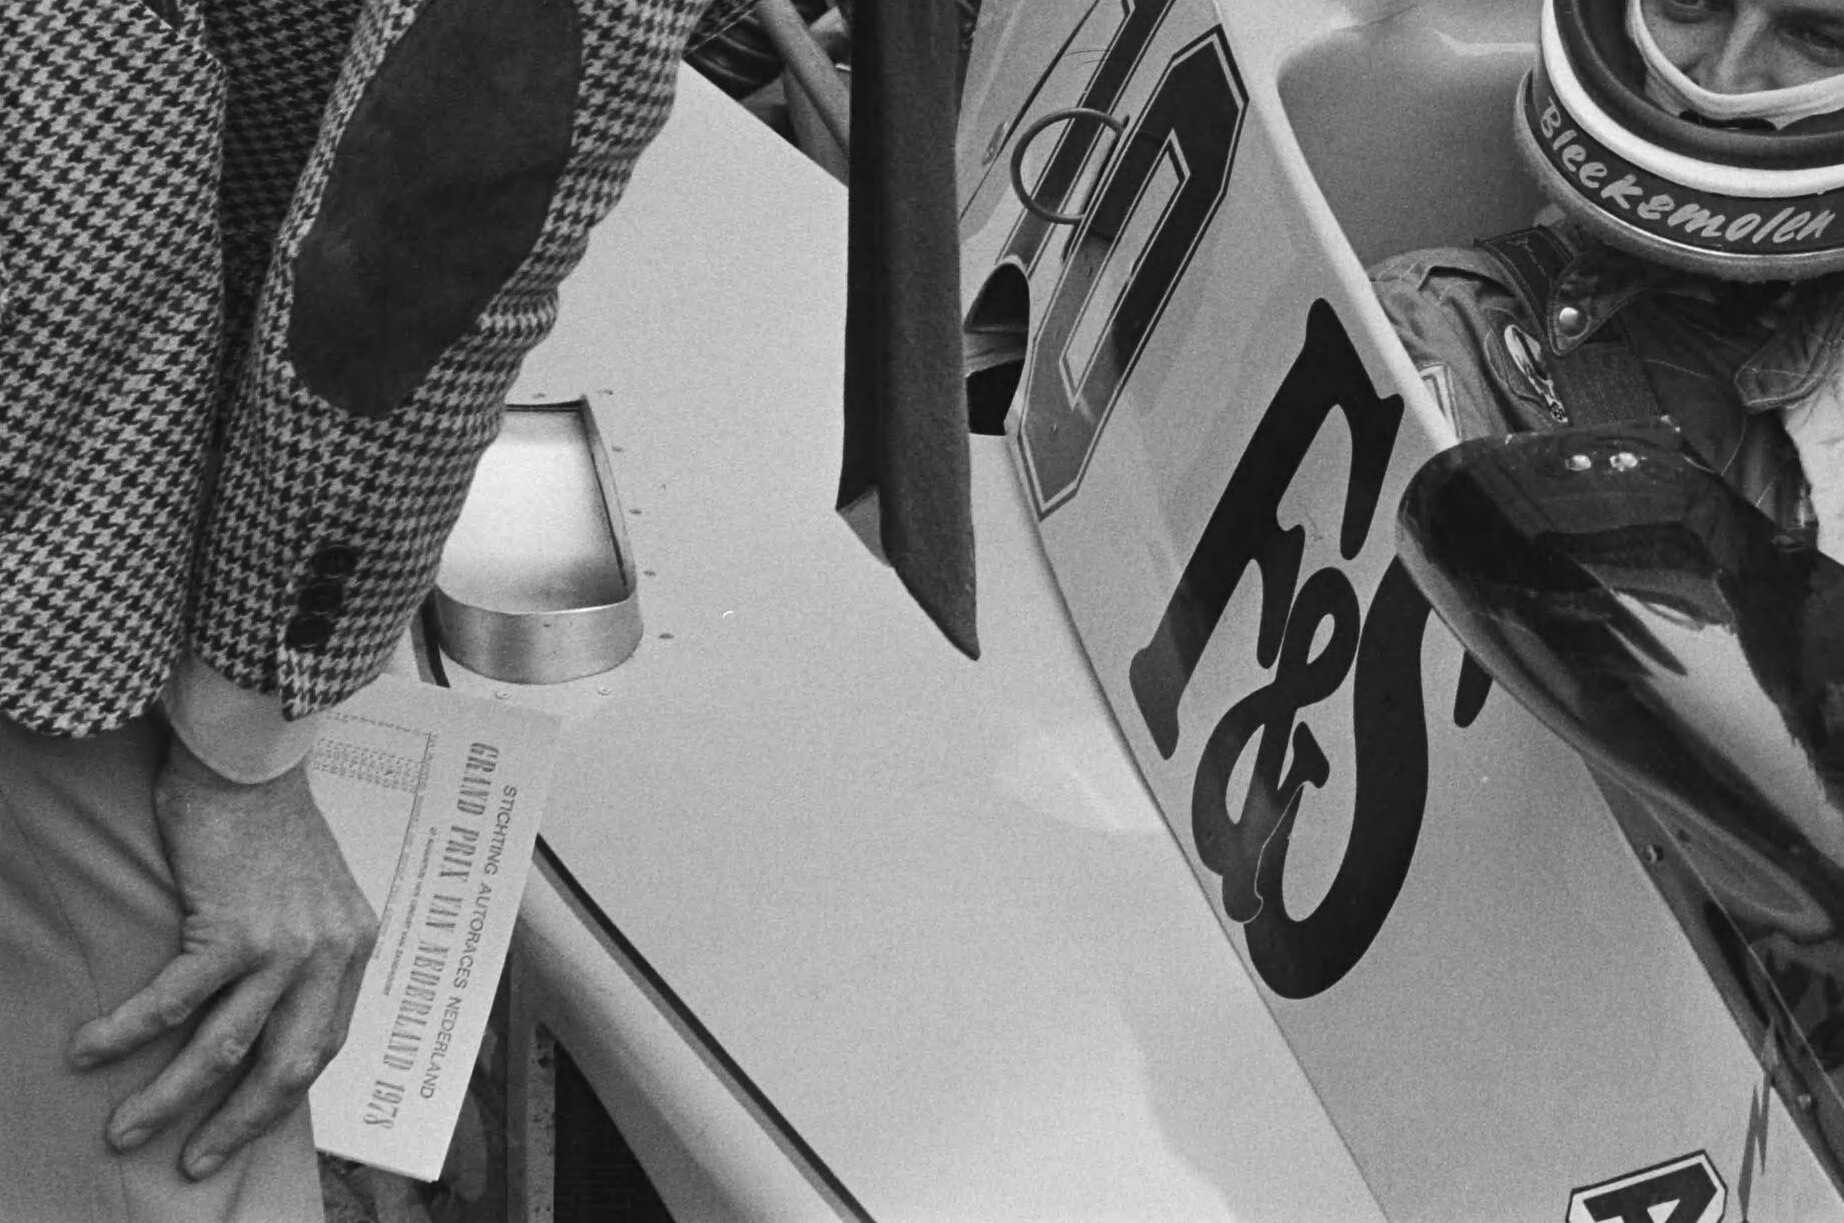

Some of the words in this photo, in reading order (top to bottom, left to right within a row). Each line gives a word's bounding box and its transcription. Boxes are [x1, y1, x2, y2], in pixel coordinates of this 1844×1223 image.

[1535, 94, 1837, 243] Bleekemolen
[455, 741, 500, 816] GRAND
[436, 825, 482, 883] PRIX
[483, 784, 518, 876] STICHTING
[423, 892, 464, 942] VAN
[451, 886, 493, 989] AUTORACES
[382, 941, 450, 1070] NEDERLAND
[418, 997, 464, 1100] NEDERLAND
[361, 1077, 407, 1130] 1978
